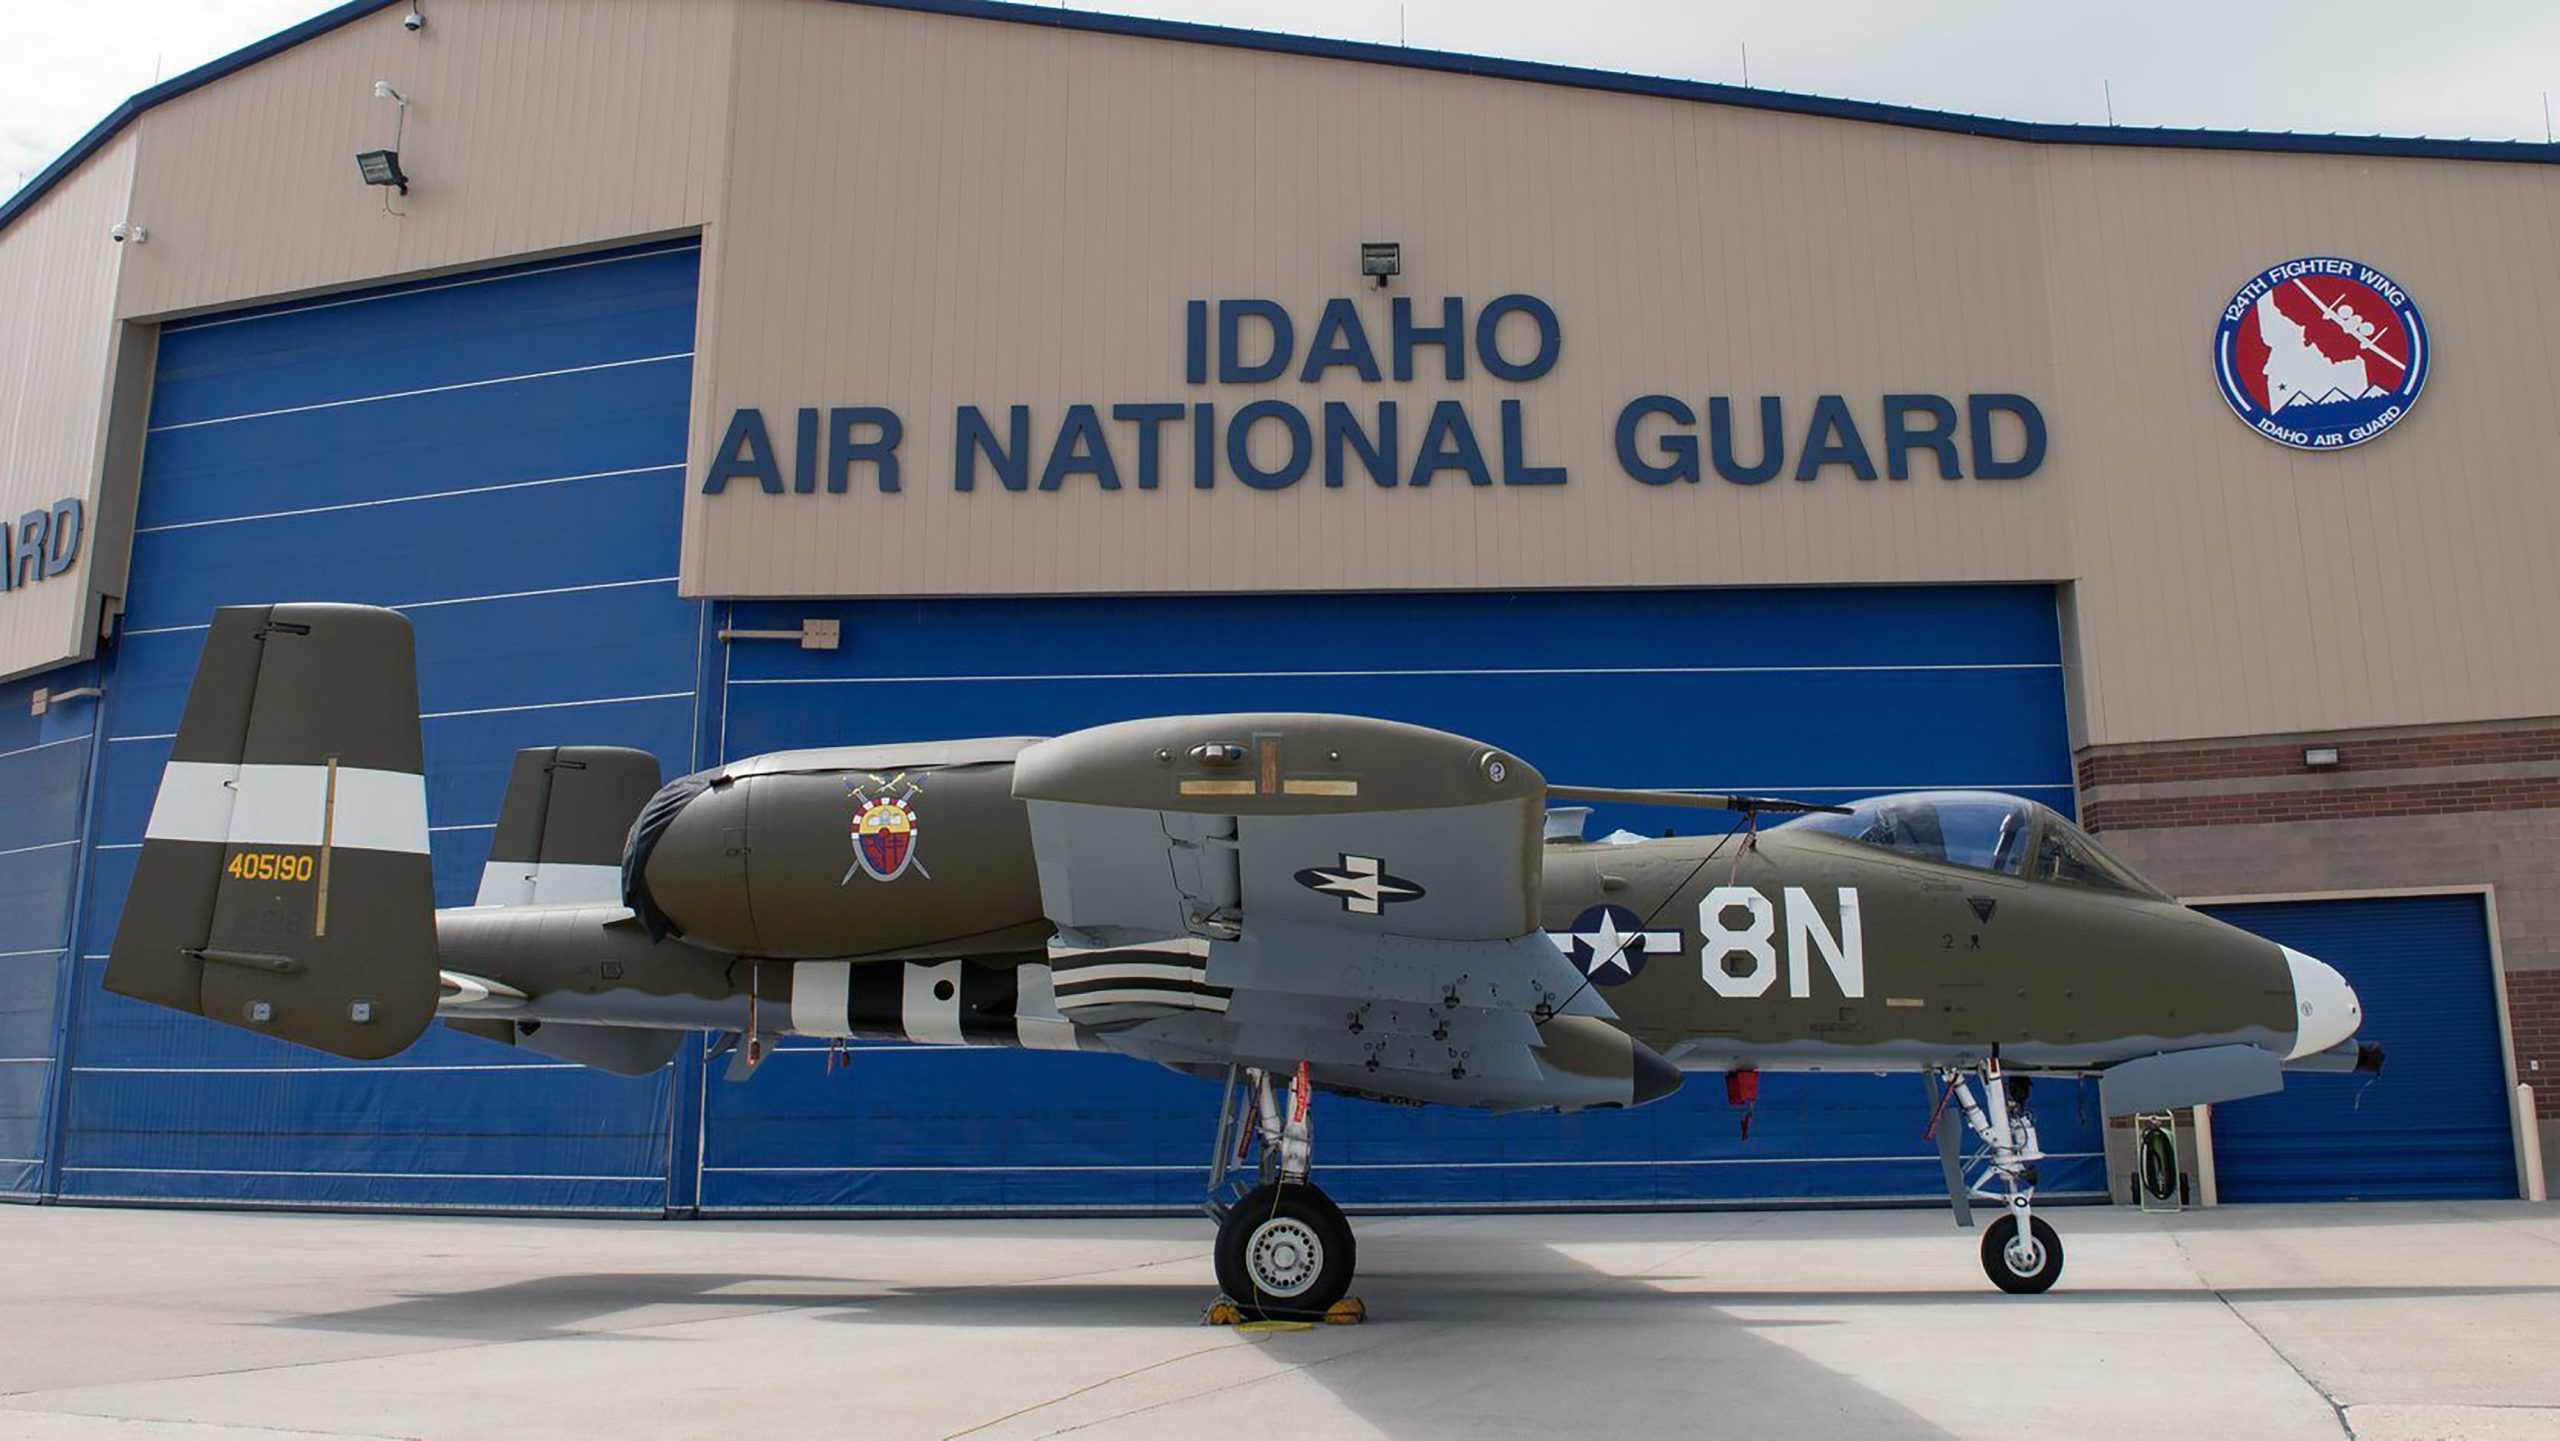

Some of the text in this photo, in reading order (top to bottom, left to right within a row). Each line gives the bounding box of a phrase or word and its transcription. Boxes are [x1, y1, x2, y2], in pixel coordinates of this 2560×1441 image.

[2225, 259, 2405, 323] 124TH FIGHTER WING
[1184, 293, 1563, 386] IDAHO
[702, 392, 2048, 497] AIR NATIONAL GUARD
[2258, 405, 2400, 446] IDAHO AIR GUARD
[228, 853, 313, 881] 405190
[1698, 886, 1865, 998] 8N
